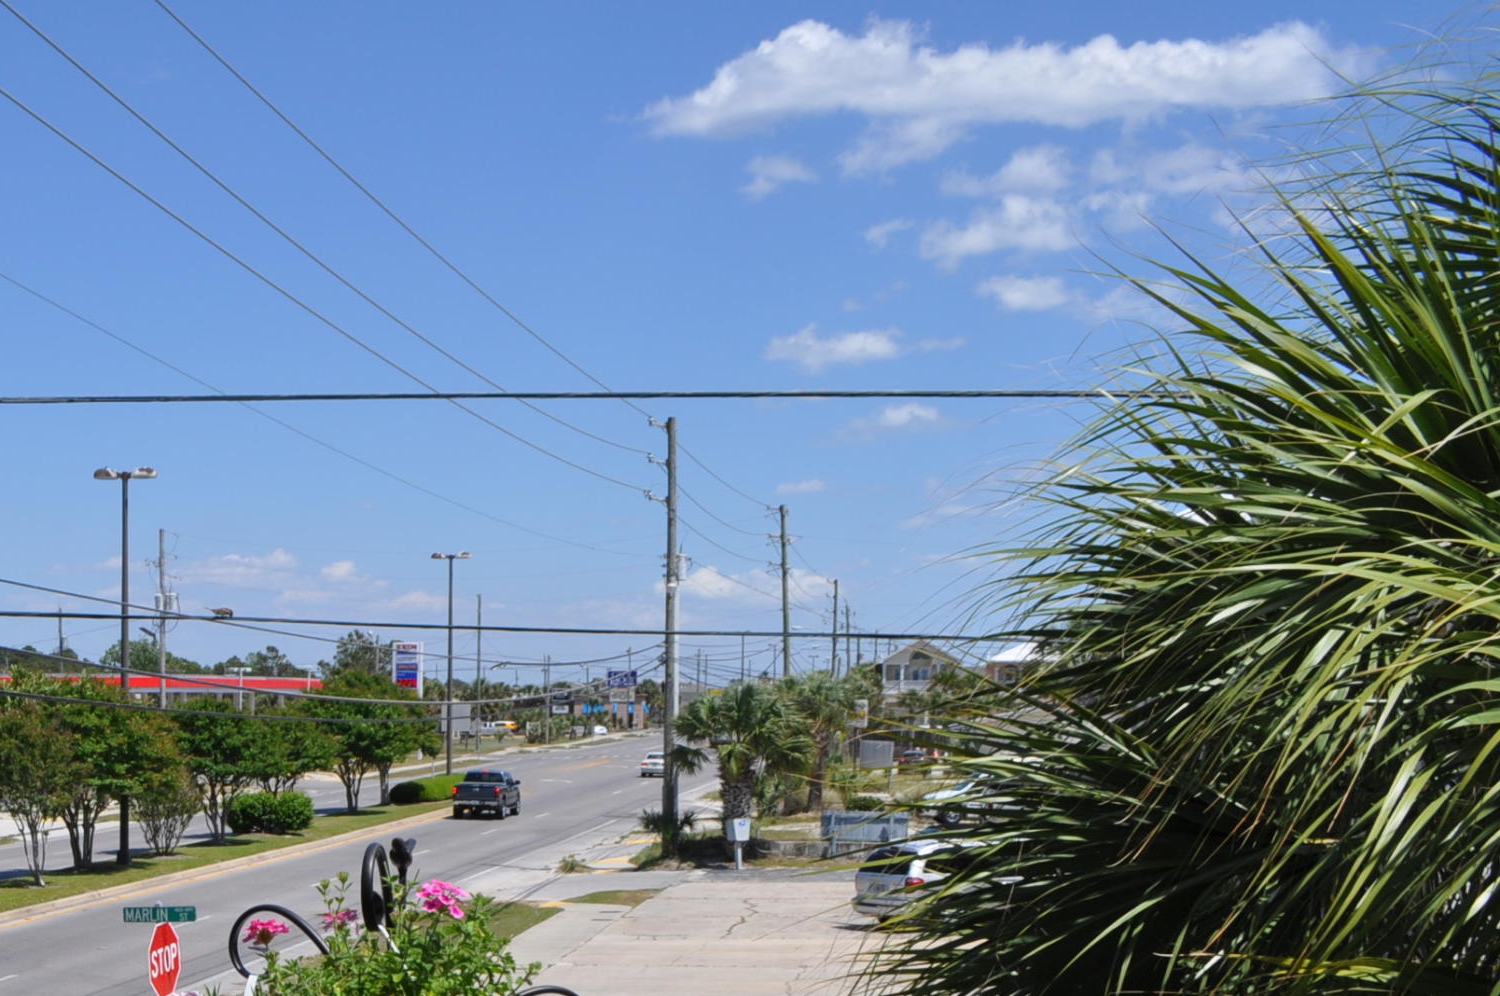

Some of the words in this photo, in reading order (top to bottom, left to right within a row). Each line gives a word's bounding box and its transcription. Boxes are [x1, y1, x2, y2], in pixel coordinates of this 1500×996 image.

[124, 908, 168, 921] MARLIN
[179, 912, 188, 921] ST
[151, 943, 177, 978] STOP
